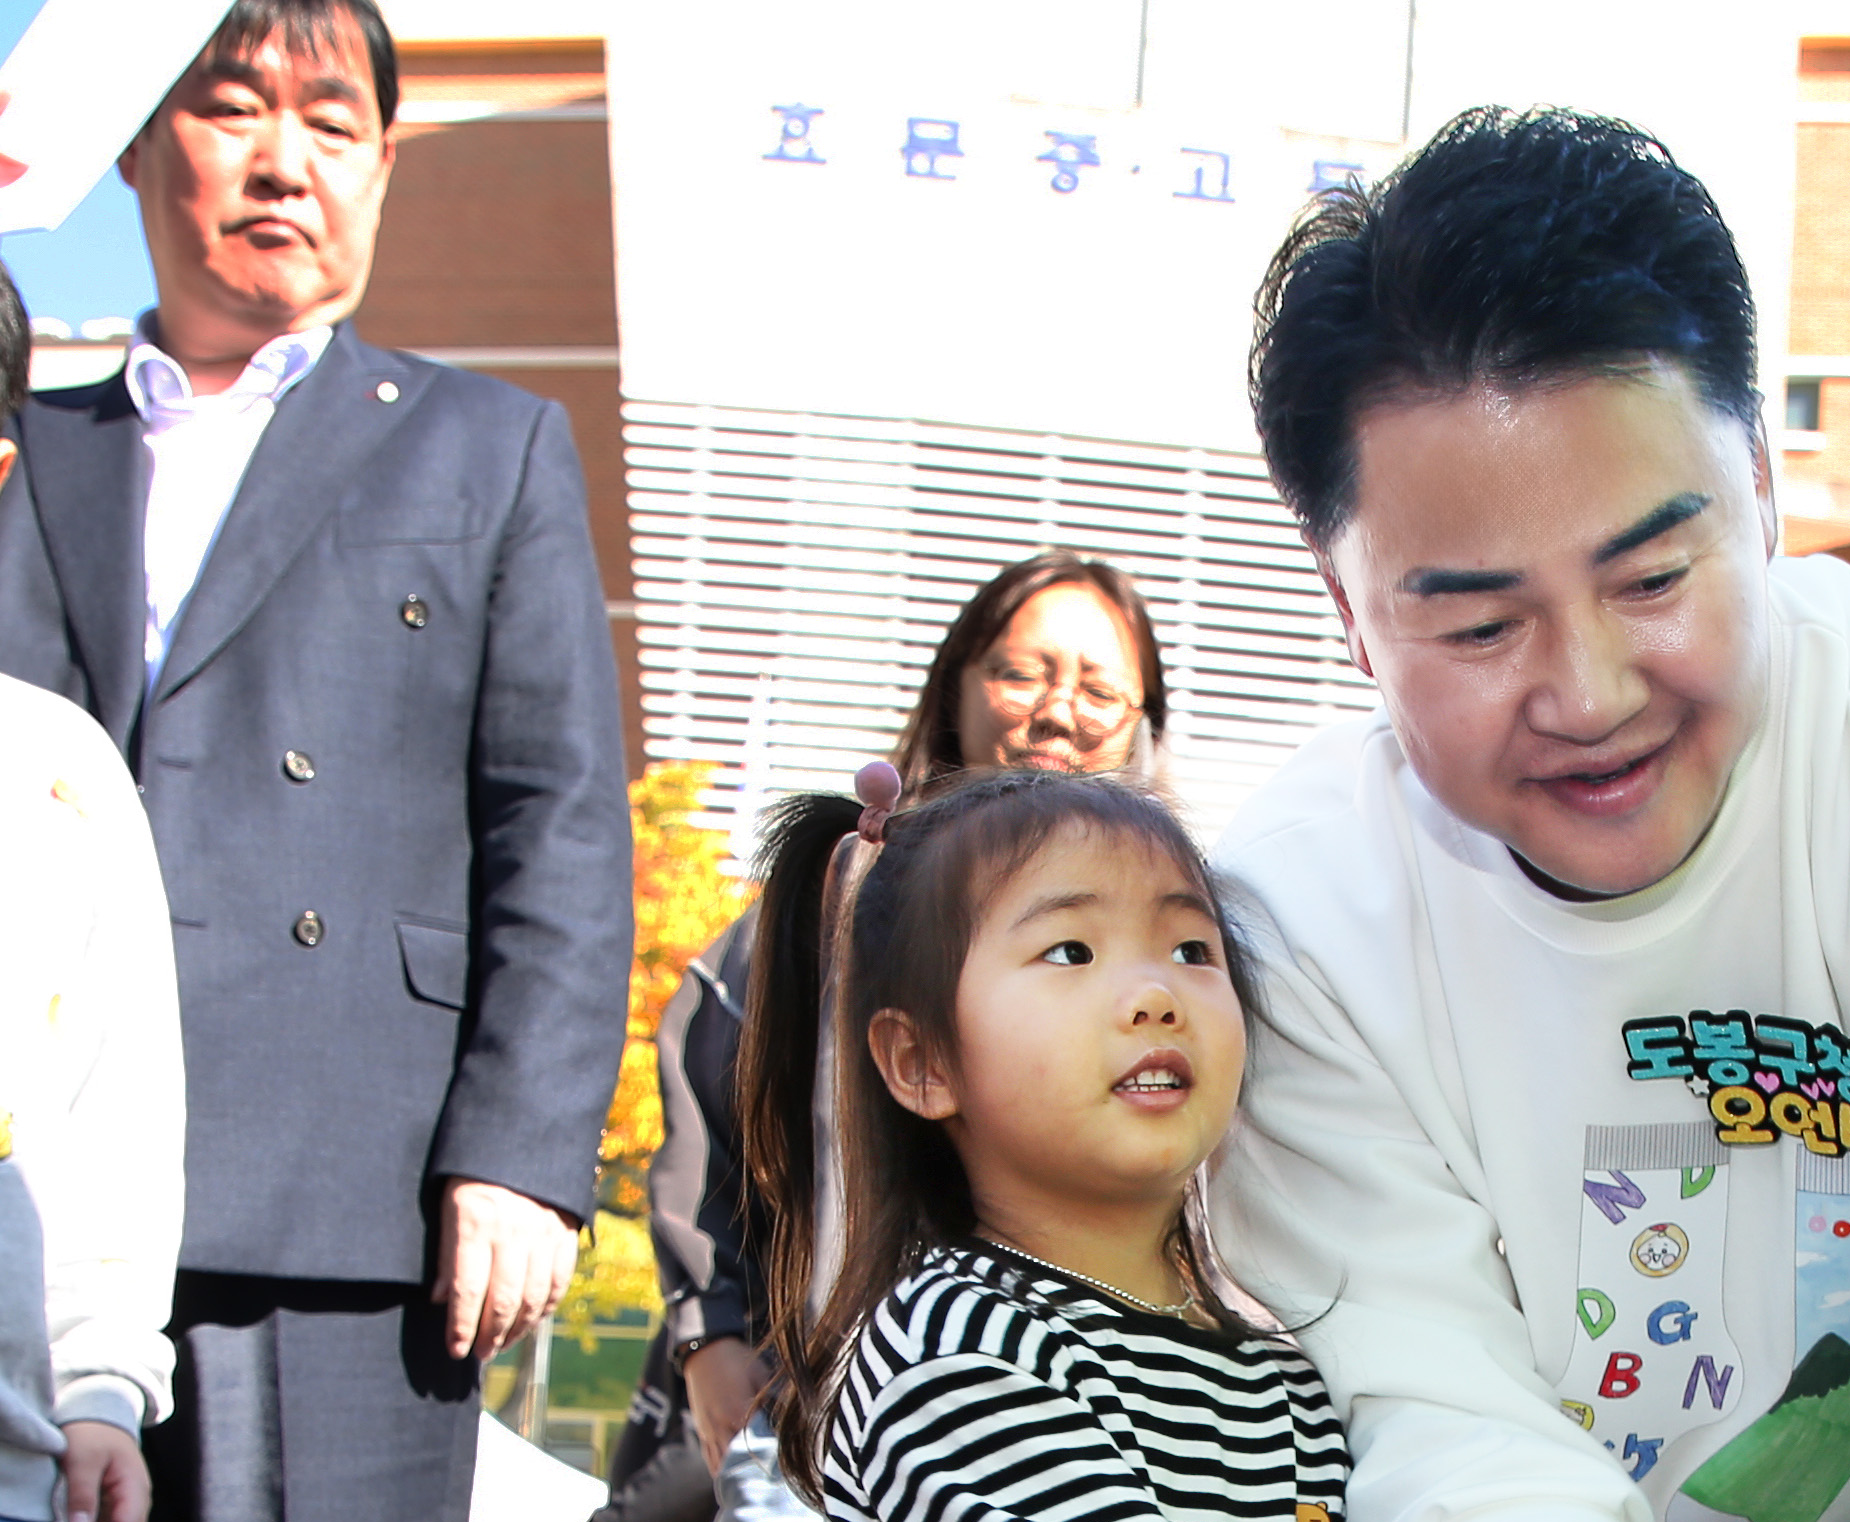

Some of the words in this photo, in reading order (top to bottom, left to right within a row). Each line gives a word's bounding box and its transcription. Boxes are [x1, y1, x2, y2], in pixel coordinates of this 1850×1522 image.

[1577, 1288, 1616, 1340] D
[1647, 1300, 1698, 1346] G
[1598, 1352, 1643, 1399] B
[1682, 1355, 1734, 1411] N
